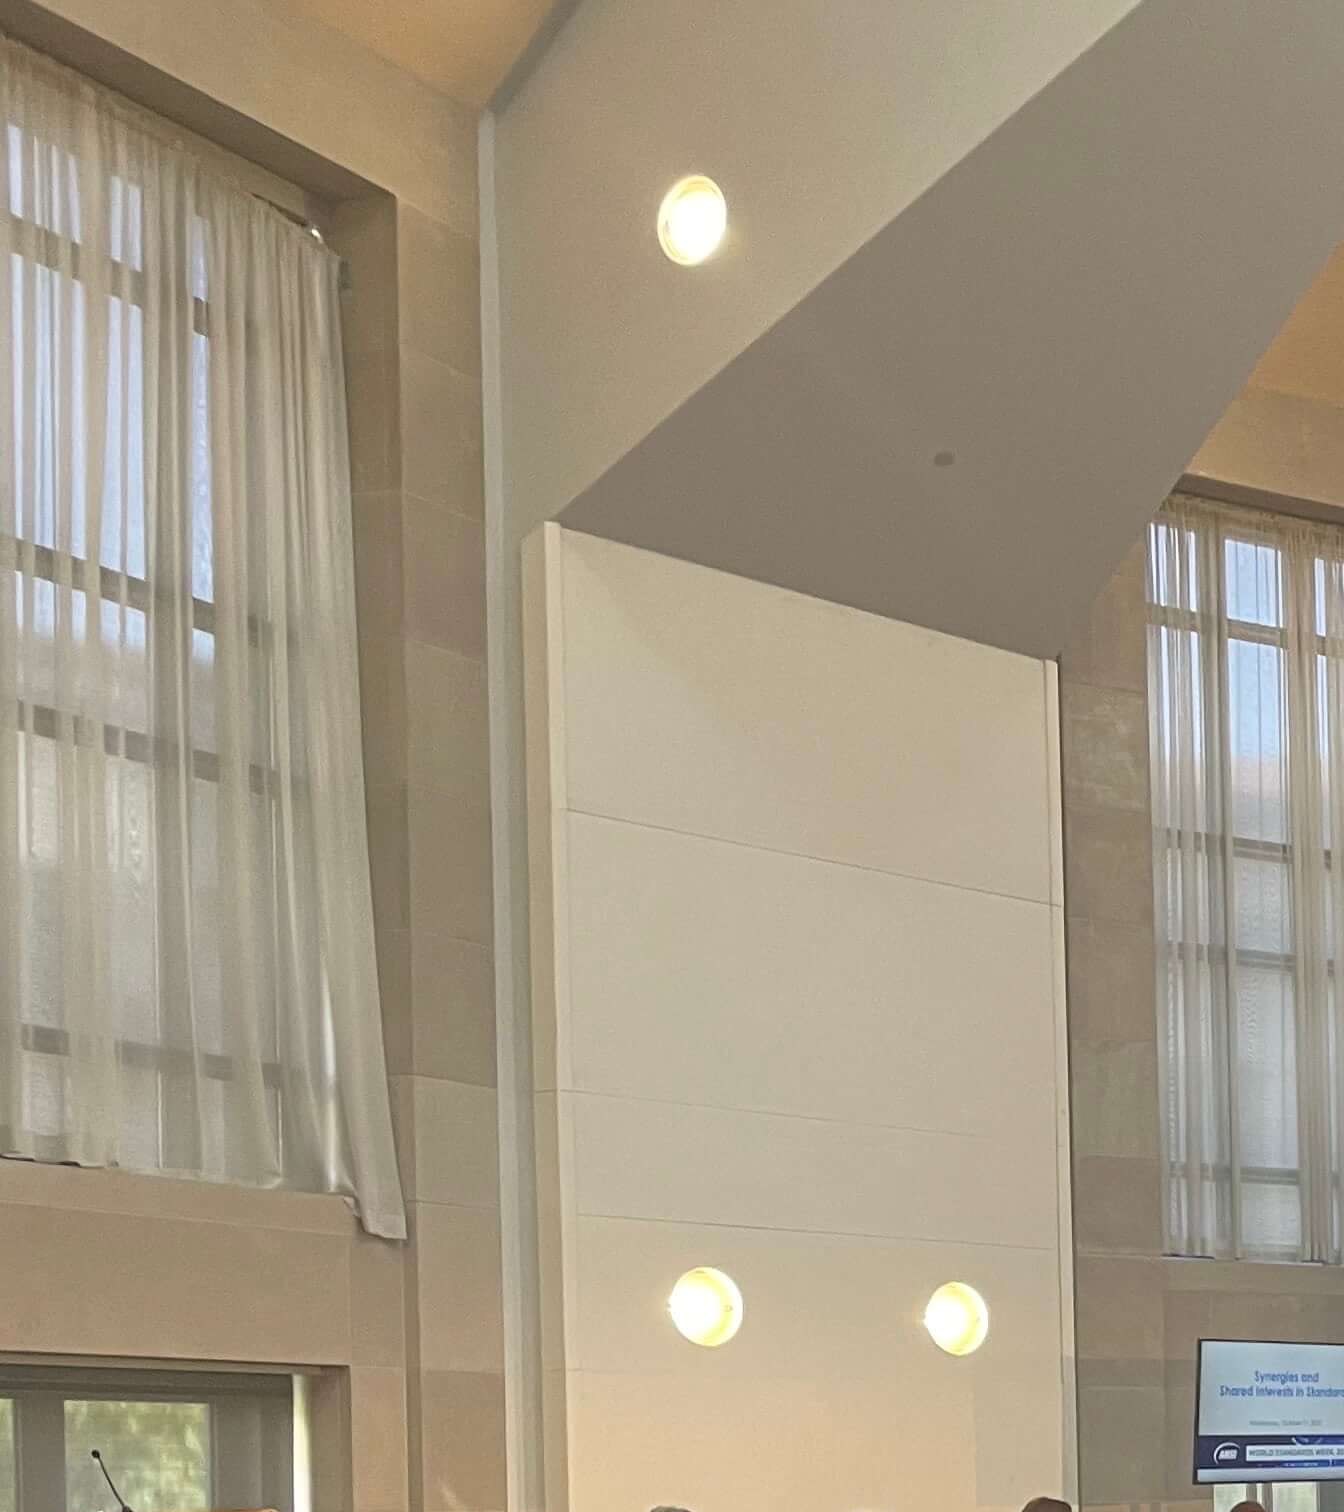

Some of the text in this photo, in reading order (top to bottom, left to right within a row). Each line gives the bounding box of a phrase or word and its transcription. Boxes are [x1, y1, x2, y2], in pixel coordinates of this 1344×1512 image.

[1254, 1370, 1320, 1384] Synergies and
[1219, 1385, 1254, 1397] Shared
[1255, 1385, 1294, 1398] Interests
[1295, 1386, 1305, 1398] in
